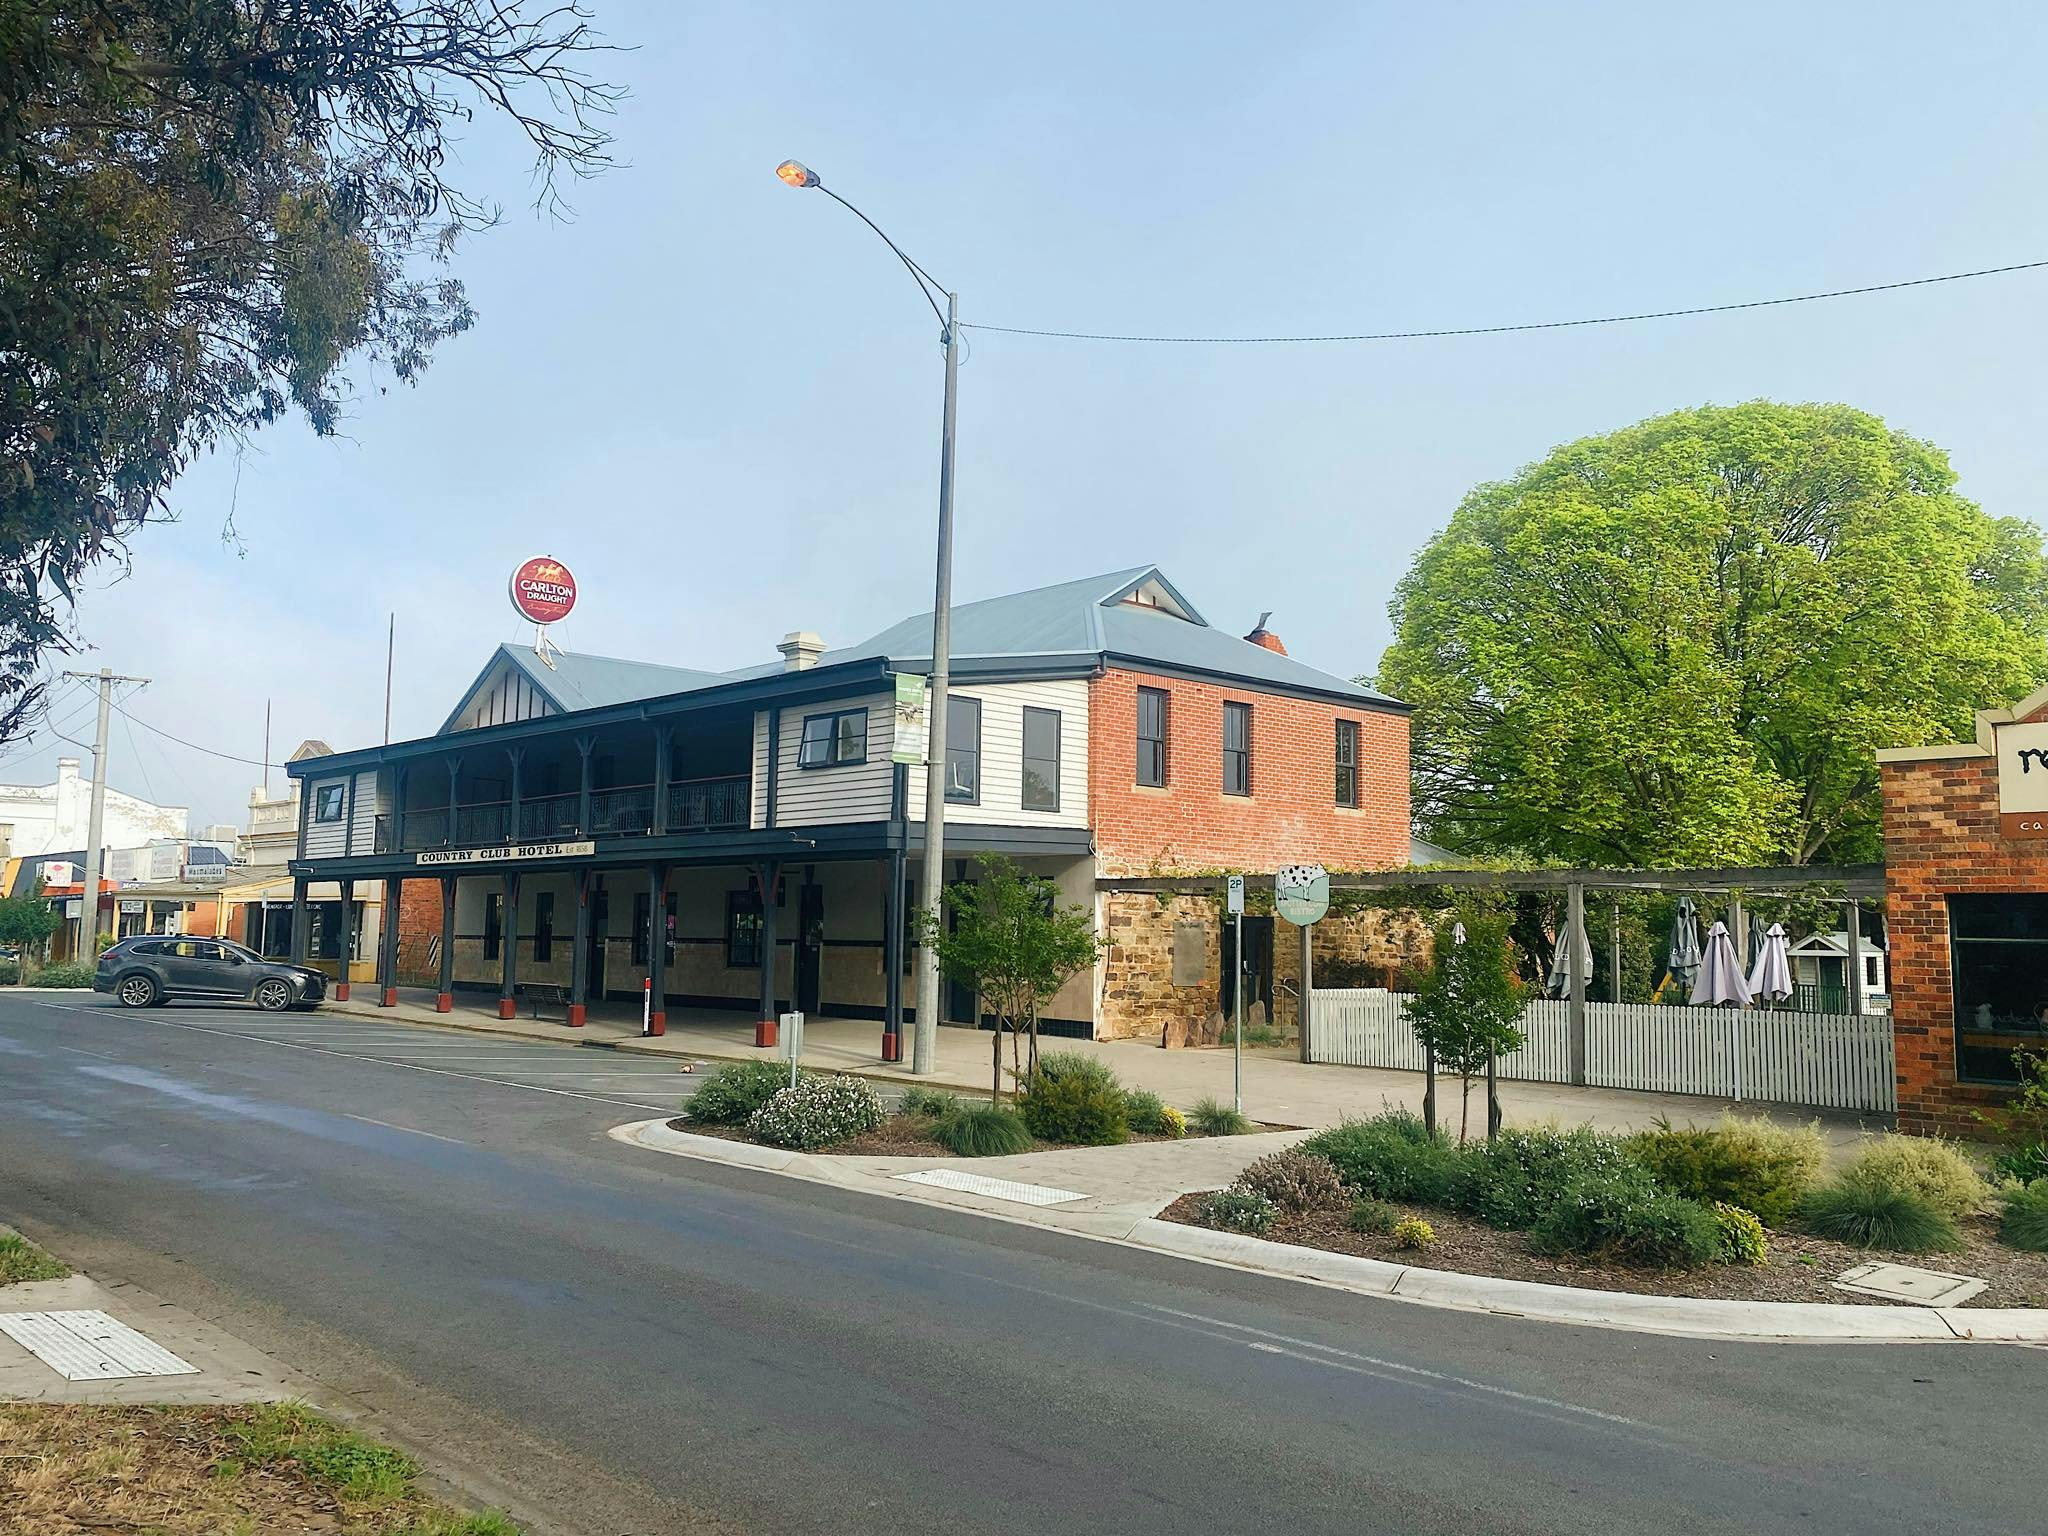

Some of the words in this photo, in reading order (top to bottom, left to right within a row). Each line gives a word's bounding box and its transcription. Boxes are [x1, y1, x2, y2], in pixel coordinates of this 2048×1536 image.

[520, 580, 573, 598] CARLTON
[526, 592, 567, 605] DRAUGHT
[2020, 822, 2048, 831] ca
[421, 851, 472, 862] COUNTRY
[480, 848, 511, 859] CLUB
[518, 845, 562, 857] HOTEL
[1230, 879, 1242, 889] 2P
